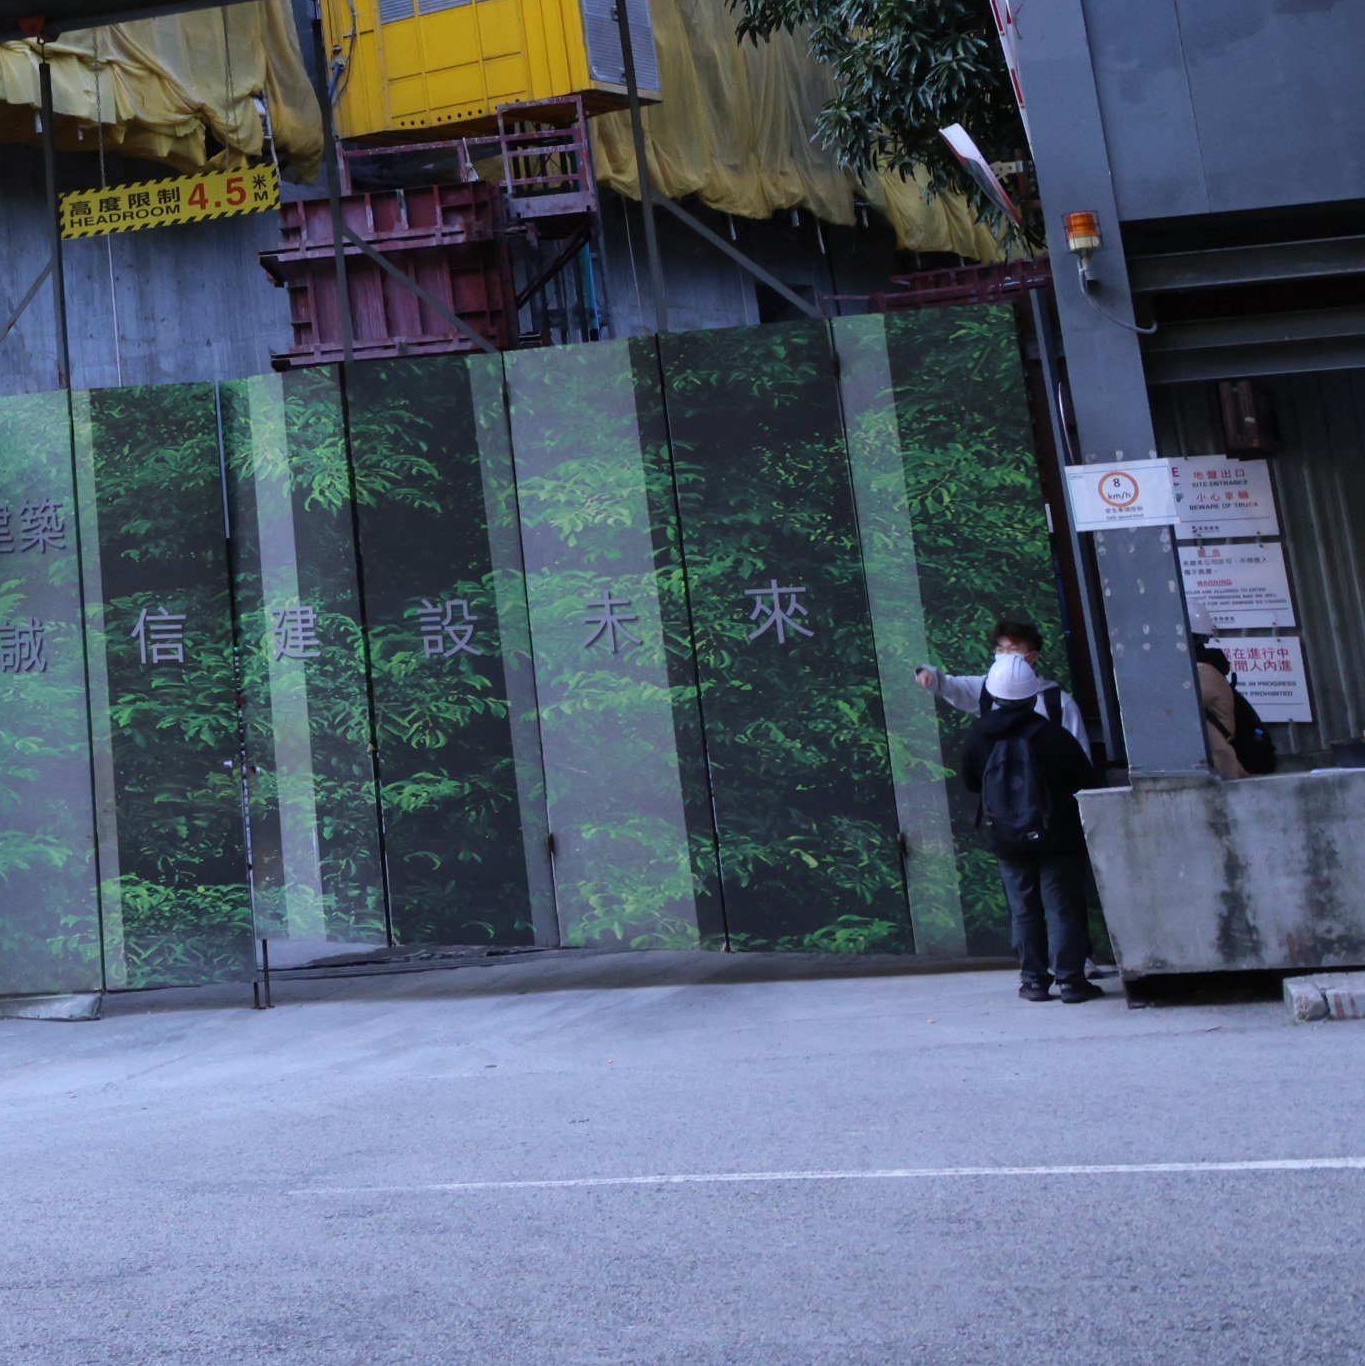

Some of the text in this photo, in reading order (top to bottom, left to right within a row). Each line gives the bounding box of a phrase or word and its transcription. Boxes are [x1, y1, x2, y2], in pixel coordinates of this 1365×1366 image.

[70, 174, 267, 218] 高度限制 4.5 米
[70, 191, 268, 228] HEADROOM M
[1113, 478, 1121, 488] 8
[1108, 491, 1131, 500] km/h
